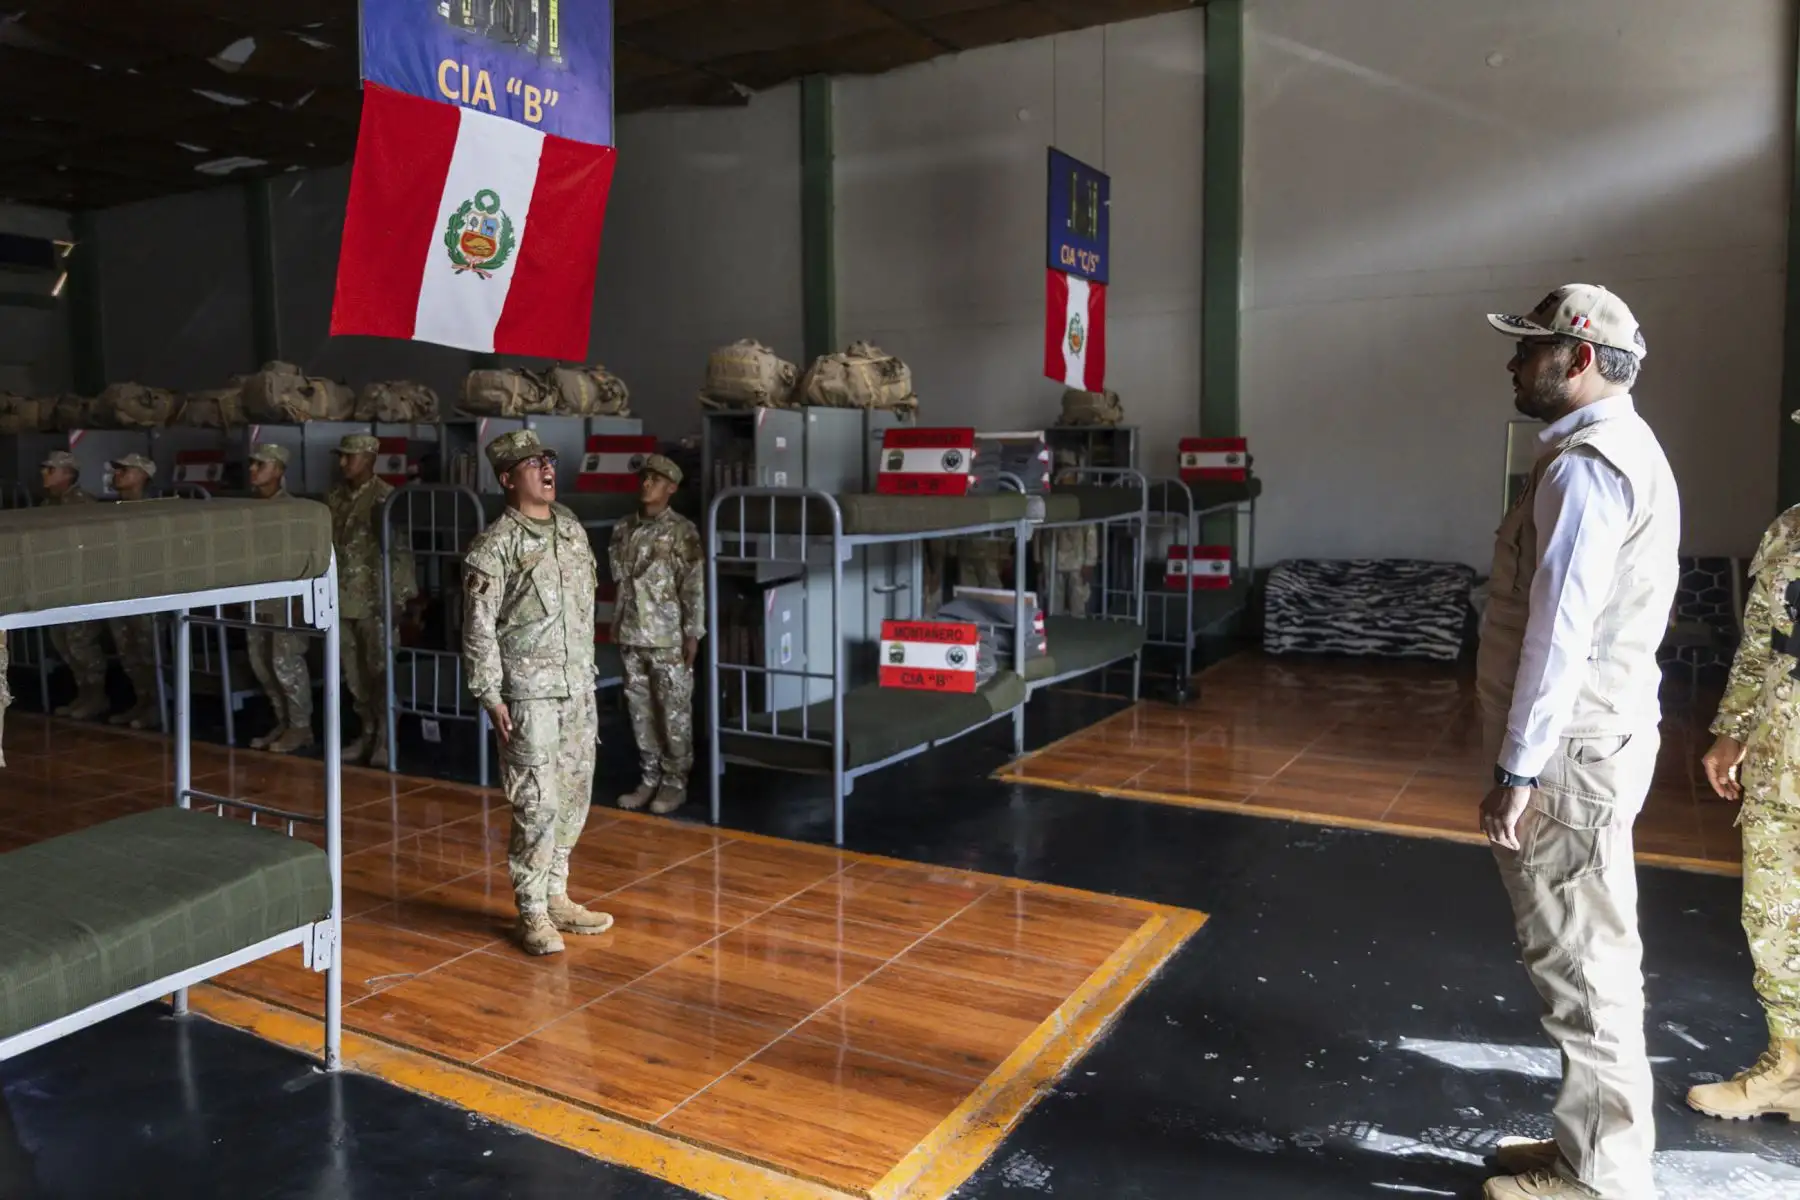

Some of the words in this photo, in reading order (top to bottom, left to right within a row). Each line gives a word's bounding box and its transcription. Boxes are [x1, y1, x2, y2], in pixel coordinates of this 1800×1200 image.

[437, 58, 497, 111] CIA
[506, 77, 559, 123] "B"
[1061, 244, 1076, 267] CIA
[894, 626, 963, 641] MONTAÑERO
[900, 672, 925, 686] CIA
